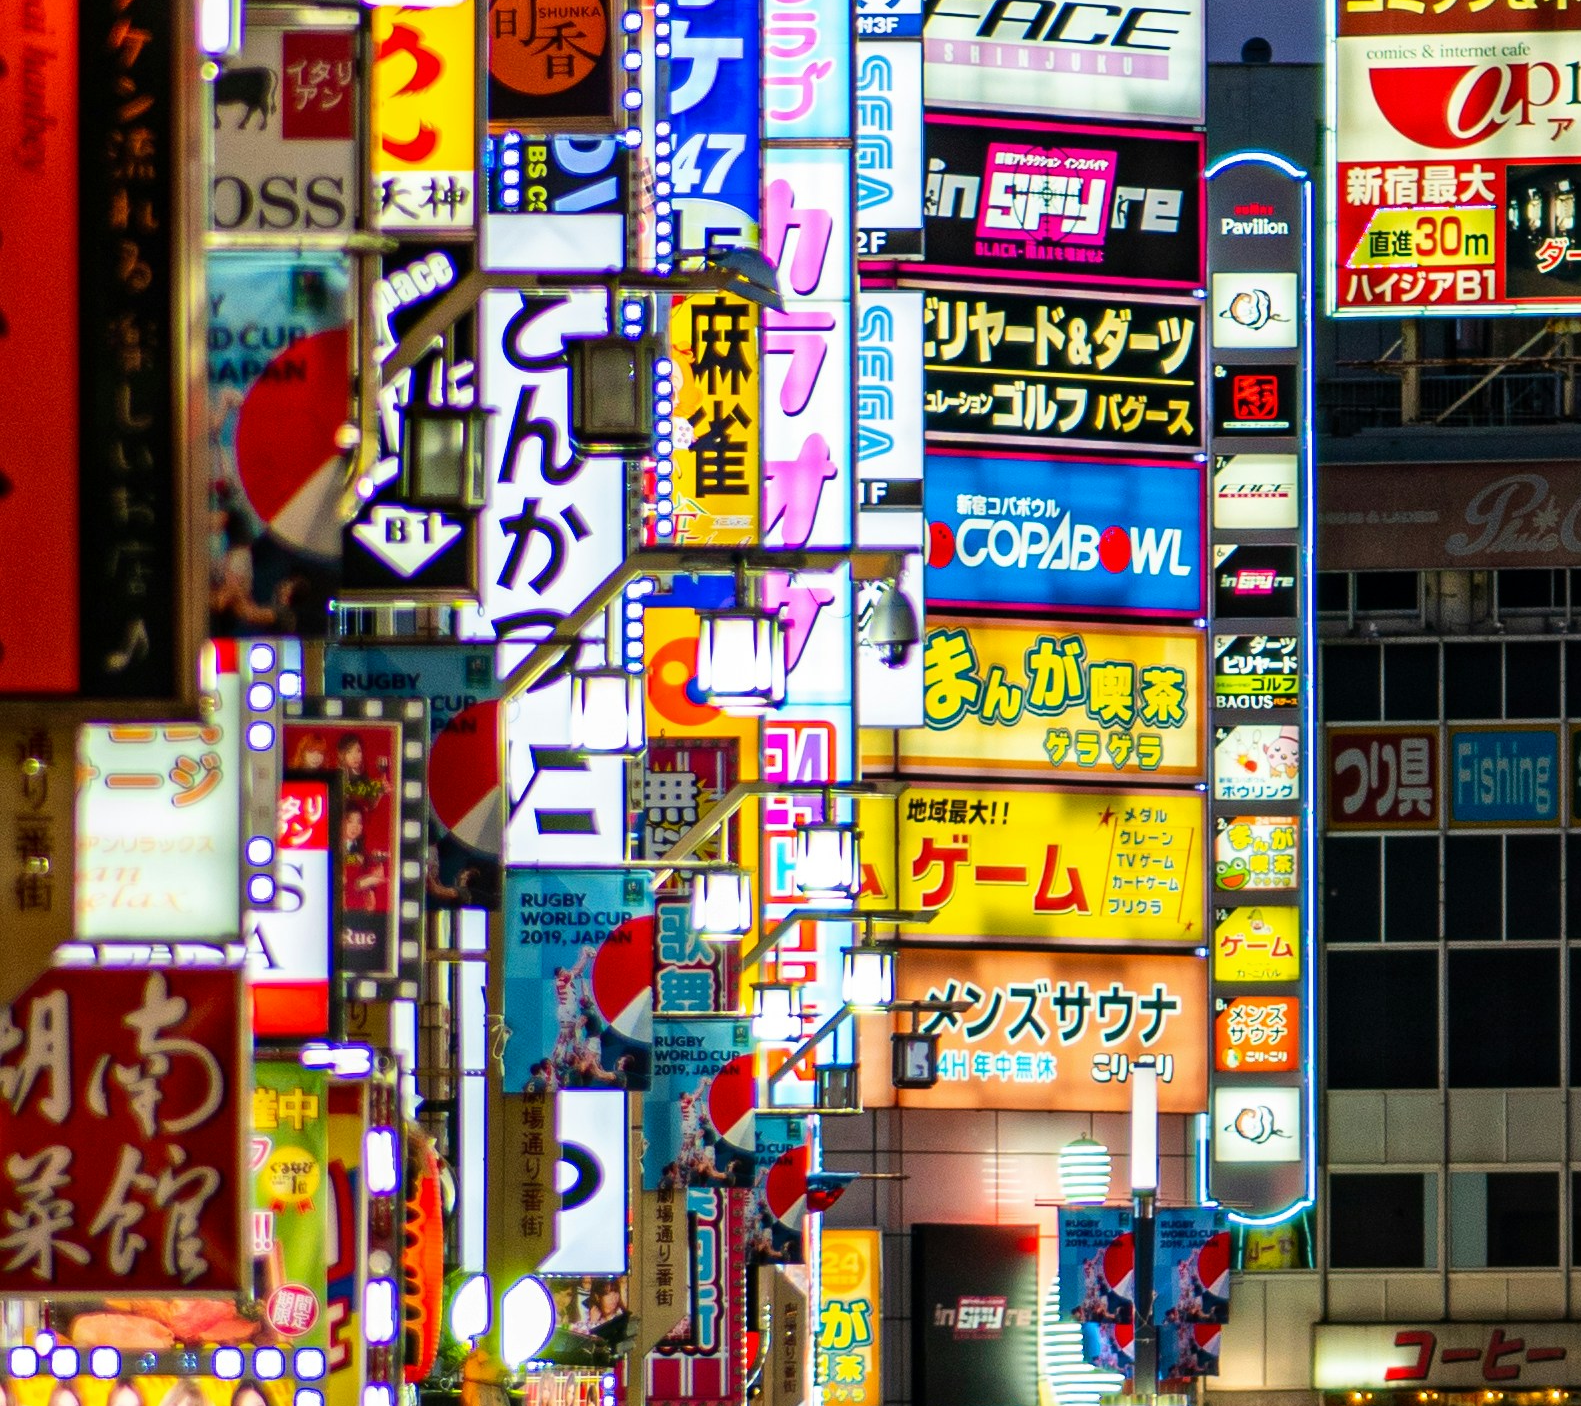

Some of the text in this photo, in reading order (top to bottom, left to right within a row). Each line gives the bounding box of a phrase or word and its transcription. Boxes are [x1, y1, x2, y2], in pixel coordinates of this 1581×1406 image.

[538, 5, 602, 20] SHUNKA
[942, 41, 1135, 78] SHINJUKU
[1366, 41, 1532, 61] comics & internet cafe
[858, 53, 894, 212] SEGA
[1345, 164, 1497, 208] 新宿最大
[1220, 217, 1289, 236] Pavilion
[1345, 267, 1497, 304] ハイジアB1
[857, 304, 895, 460] SEGA
[688, 295, 754, 500] 麻雀
[1095, 393, 1195, 436] バグース
[956, 493, 1061, 519] 新宿コパボウル
[1249, 635, 1298, 656] ダーツ
[1222, 655, 1299, 675] ビリヤード
[341, 672, 421, 690] RUGBY
[925, 627, 1188, 729] まんが喫茶
[1250, 676, 1298, 693] ゴルフ
[1215, 694, 1274, 709] BAGUS
[1044, 730, 1164, 771] ゲラゲラ
[1333, 737, 1433, 819] つり具
[1456, 741, 1554, 815] Fishing
[1221, 784, 1294, 799] ボウリング
[906, 797, 1010, 825] 地域最大!!
[1123, 807, 1168, 824] メダル
[1119, 830, 1174, 847] クレーン
[1227, 823, 1296, 852] まんが
[911, 833, 1093, 916] ゲーム
[1248, 853, 1296, 876] 喫茶
[1111, 875, 1180, 892] カードゲーム
[520, 892, 588, 909] RUGBY
[520, 910, 634, 927] WORLD CUP
[520, 928, 634, 947] 2019, JAPAN
[1220, 934, 1295, 958] ゲーム
[922, 977, 1183, 1046] メンズサウナ
[1227, 1003, 1288, 1024] メンズ
[654, 1036, 705, 1049] RUGBY
[1229, 1025, 1288, 1046] サウナ
[654, 1050, 742, 1063] WORLD CUP
[972, 1051, 1058, 1082] 年中無休
[654, 1064, 741, 1077] 2019, JAPAN
[1384, 1327, 1567, 1383] コーヒー
